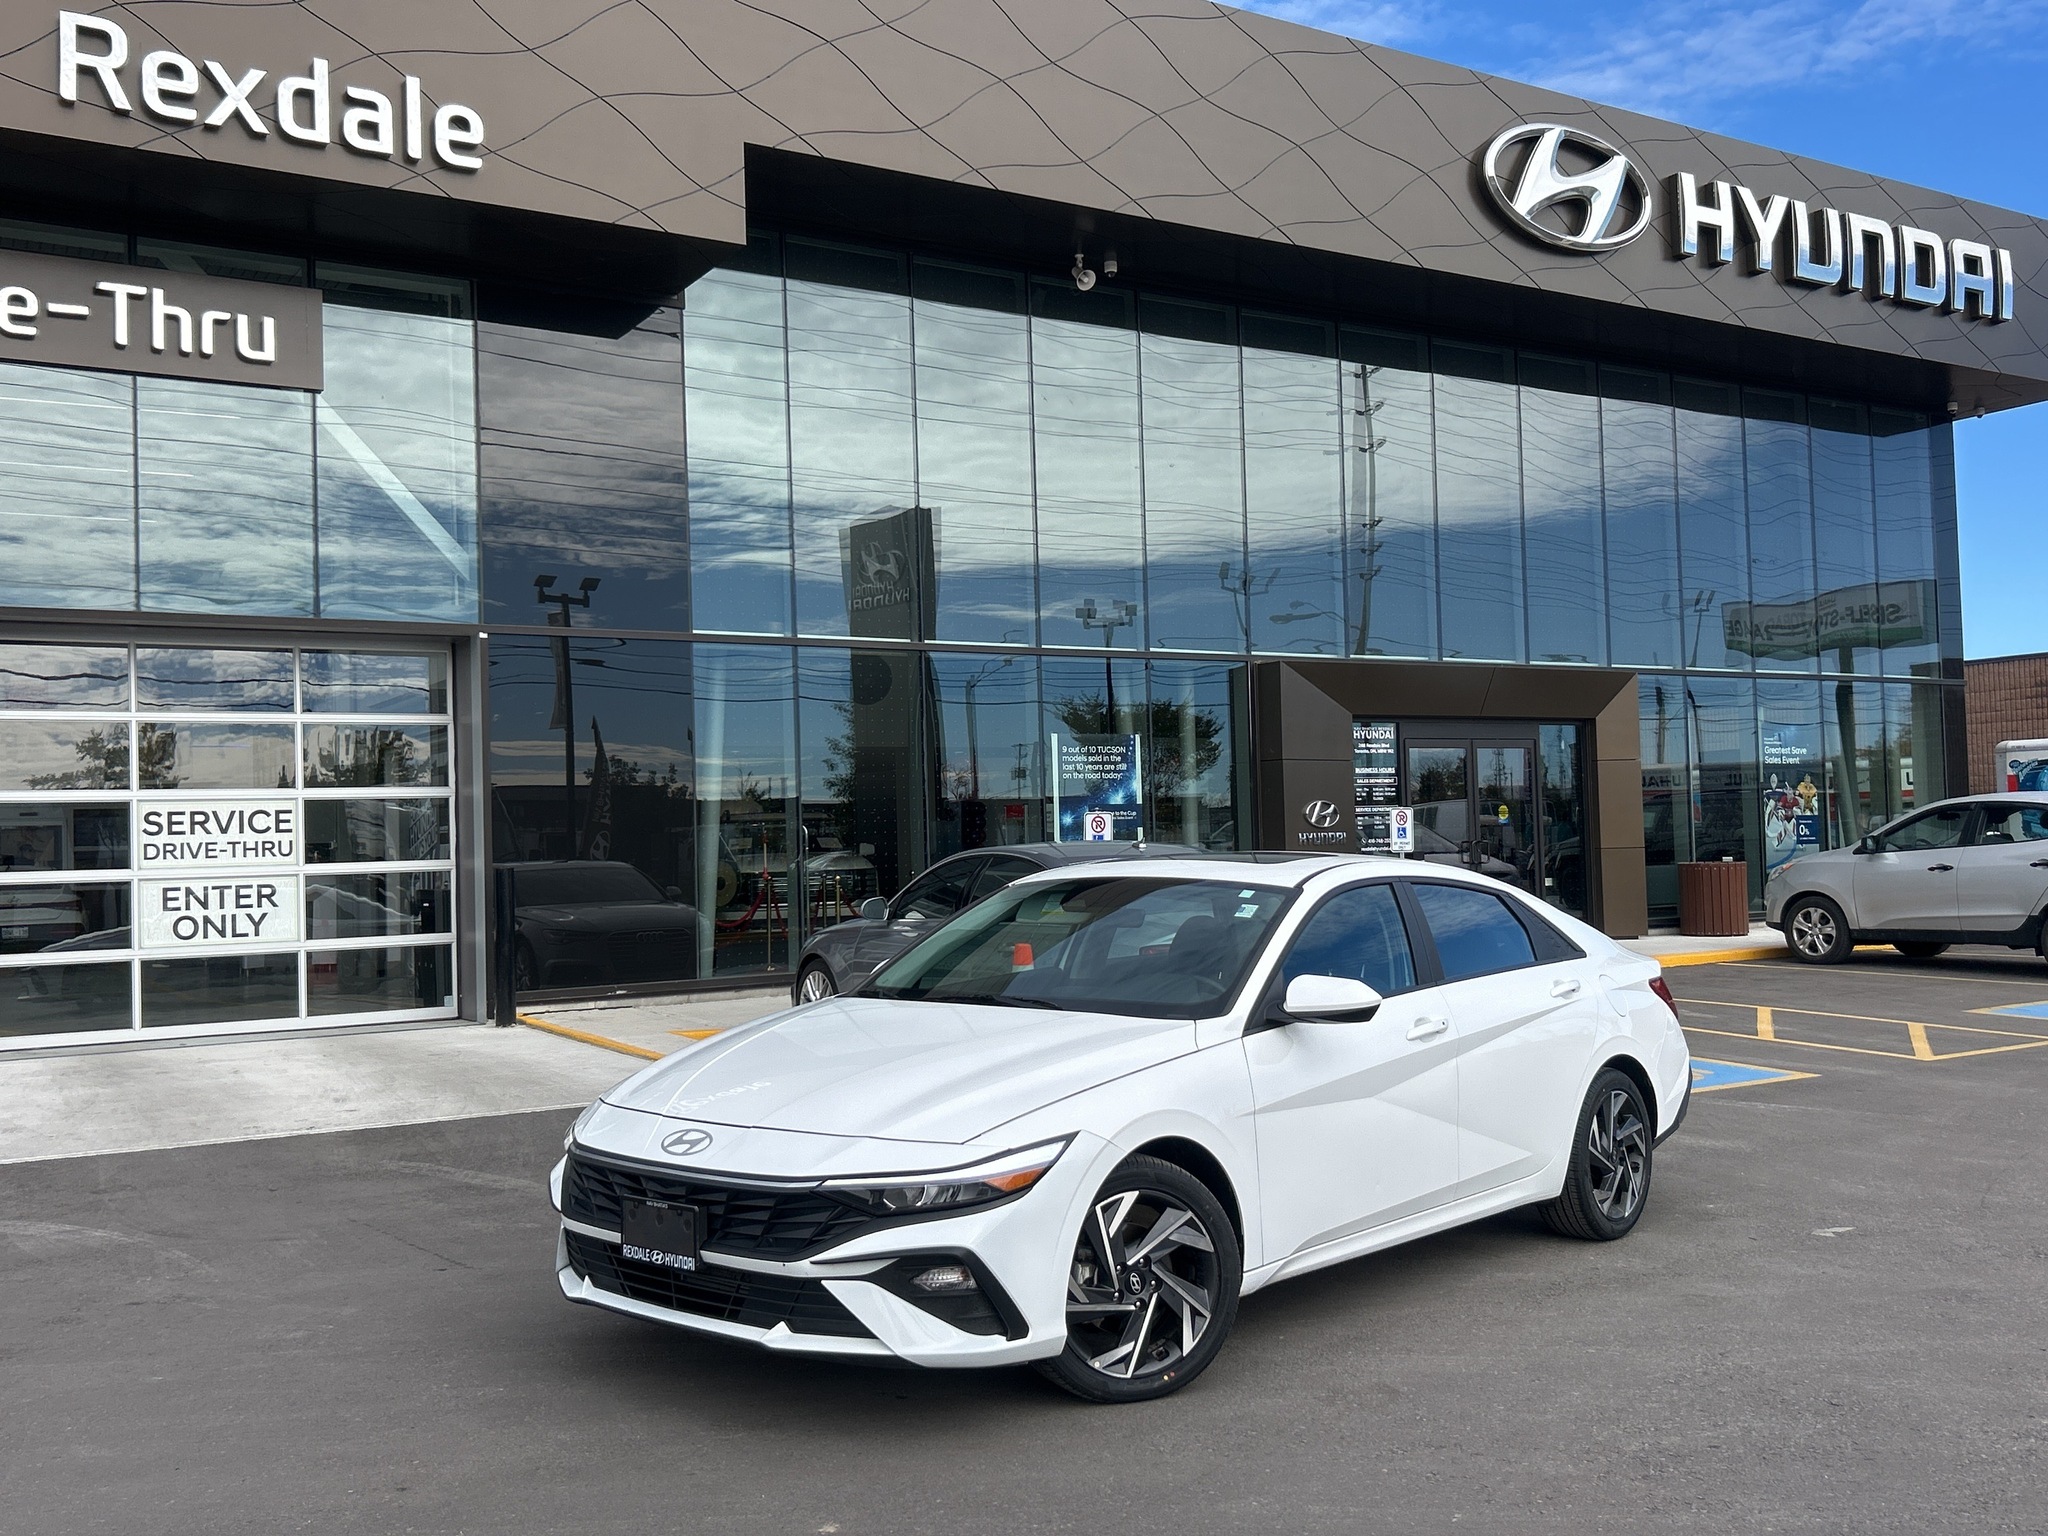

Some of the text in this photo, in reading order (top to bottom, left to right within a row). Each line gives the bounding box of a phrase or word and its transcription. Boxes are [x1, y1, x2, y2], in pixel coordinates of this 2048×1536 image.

[57, 9, 486, 171] Rexdale
[1671, 171, 2014, 322] HYUNDAI
[1353, 728, 1394, 740] HYUNDAI
[1062, 754, 1121, 762] models sold in the
[1764, 746, 1807, 754] Greatest Save
[1764, 756, 1800, 764] Sales Event
[1085, 764, 1103, 772] years
[142, 809, 293, 836] SERVICE
[1298, 832, 1346, 845] HYUNDAI
[143, 840, 293, 861] DRIVE-THRU
[162, 884, 279, 912] ENTER
[172, 912, 269, 941] ONLY
[623, 1244, 696, 1271] REXDALE HYUNDAI
